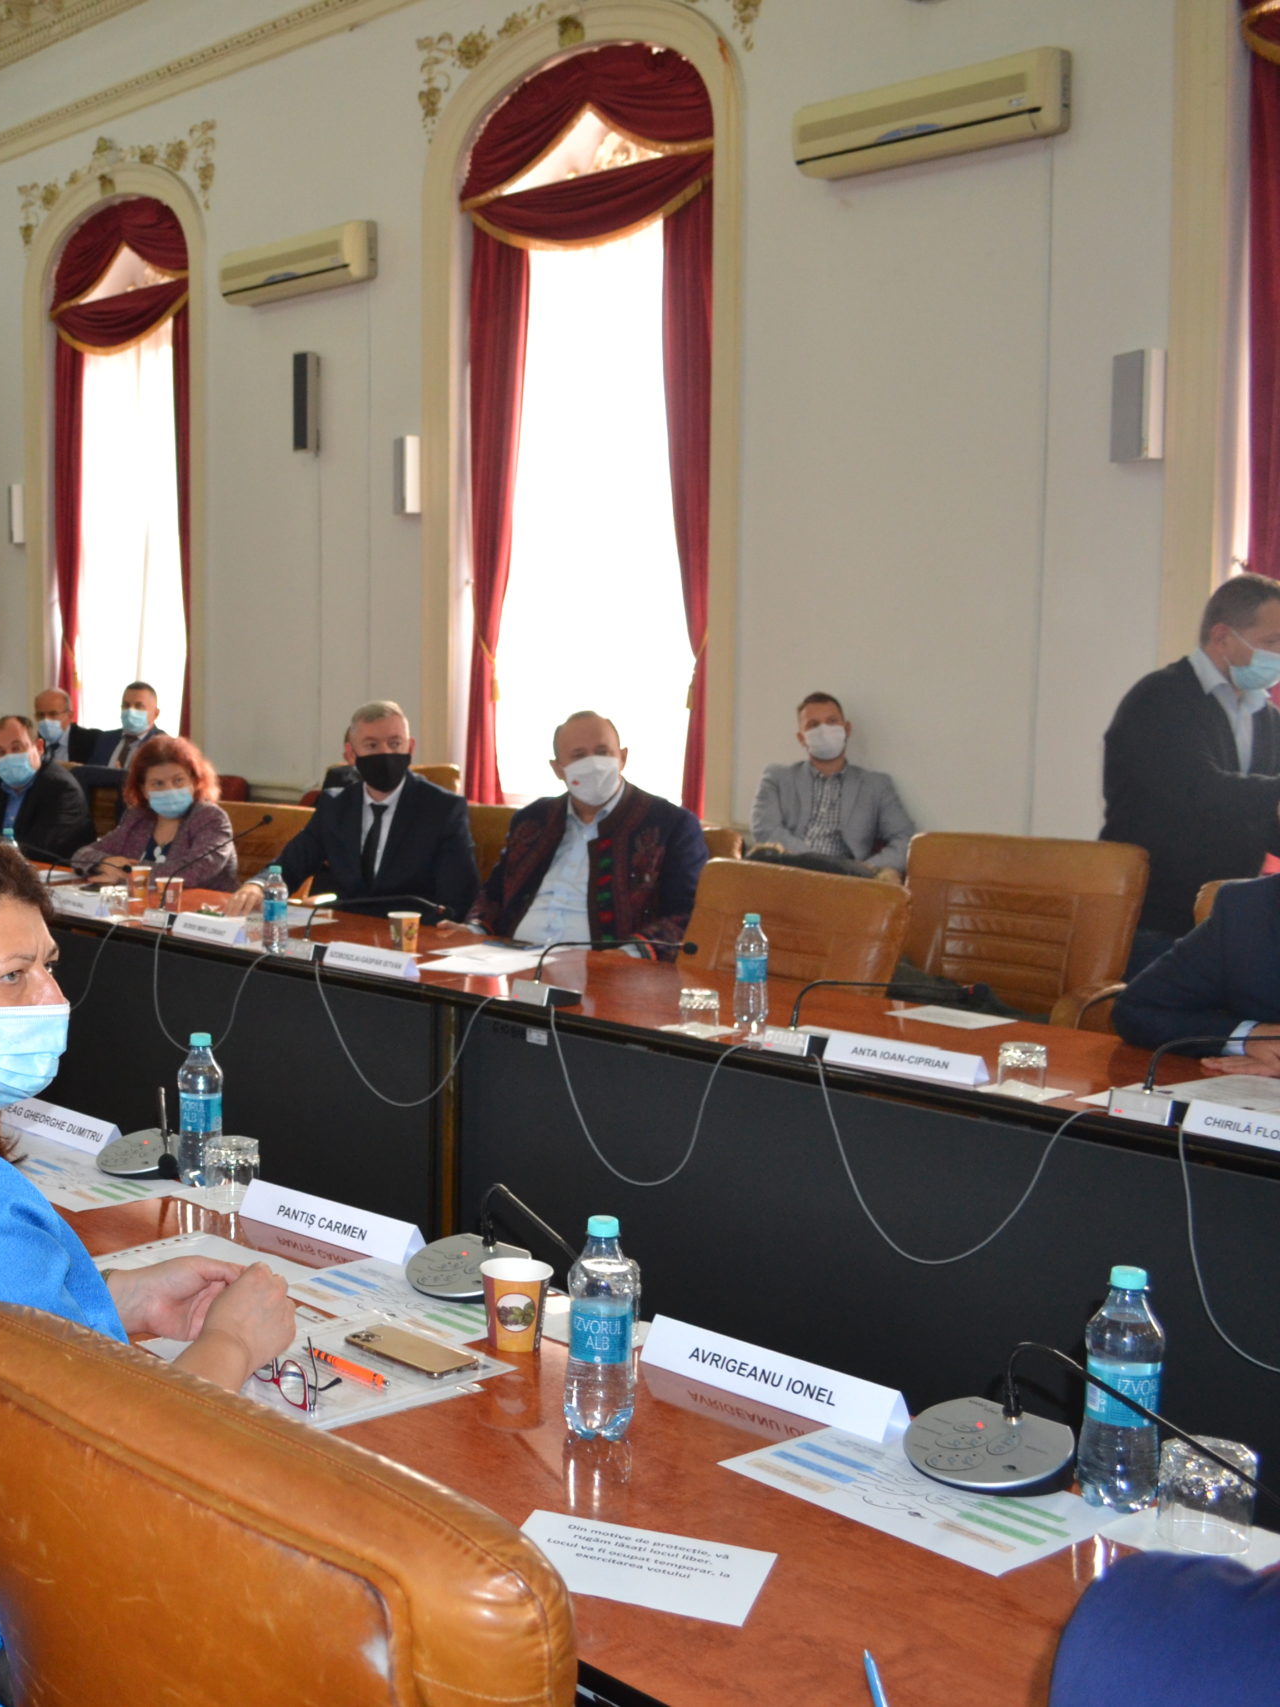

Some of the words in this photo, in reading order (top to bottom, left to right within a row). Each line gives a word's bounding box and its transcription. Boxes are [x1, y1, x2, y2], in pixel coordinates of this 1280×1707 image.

[851, 1046, 878, 1058] ANTA
[879, 1051, 950, 1069] IOAN-CIPRIAN
[4, 1104, 23, 1116] EAG
[23, 1109, 67, 1131] GHEORGHE
[66, 1123, 104, 1142] DUMITRU
[1204, 1116, 1252, 1134] CHIRILĂ
[1255, 1126, 1280, 1140] FLO
[276, 1204, 317, 1228] PANTIȘ
[318, 1217, 368, 1241] CARMEN
[574, 1315, 623, 1335] IZVORUL
[585, 1335, 610, 1350] ALB
[688, 1347, 784, 1388] AVRIGEANU
[785, 1377, 836, 1407] IONEL
[567, 1524, 588, 1532] Din
[590, 1529, 632, 1540] motive
[546, 1538, 578, 1548] Locul
[608, 1550, 651, 1562] ocupat
[650, 1548, 680, 1558] locul
[575, 1552, 644, 1569] exercitarea
[647, 1567, 691, 1579] votului
